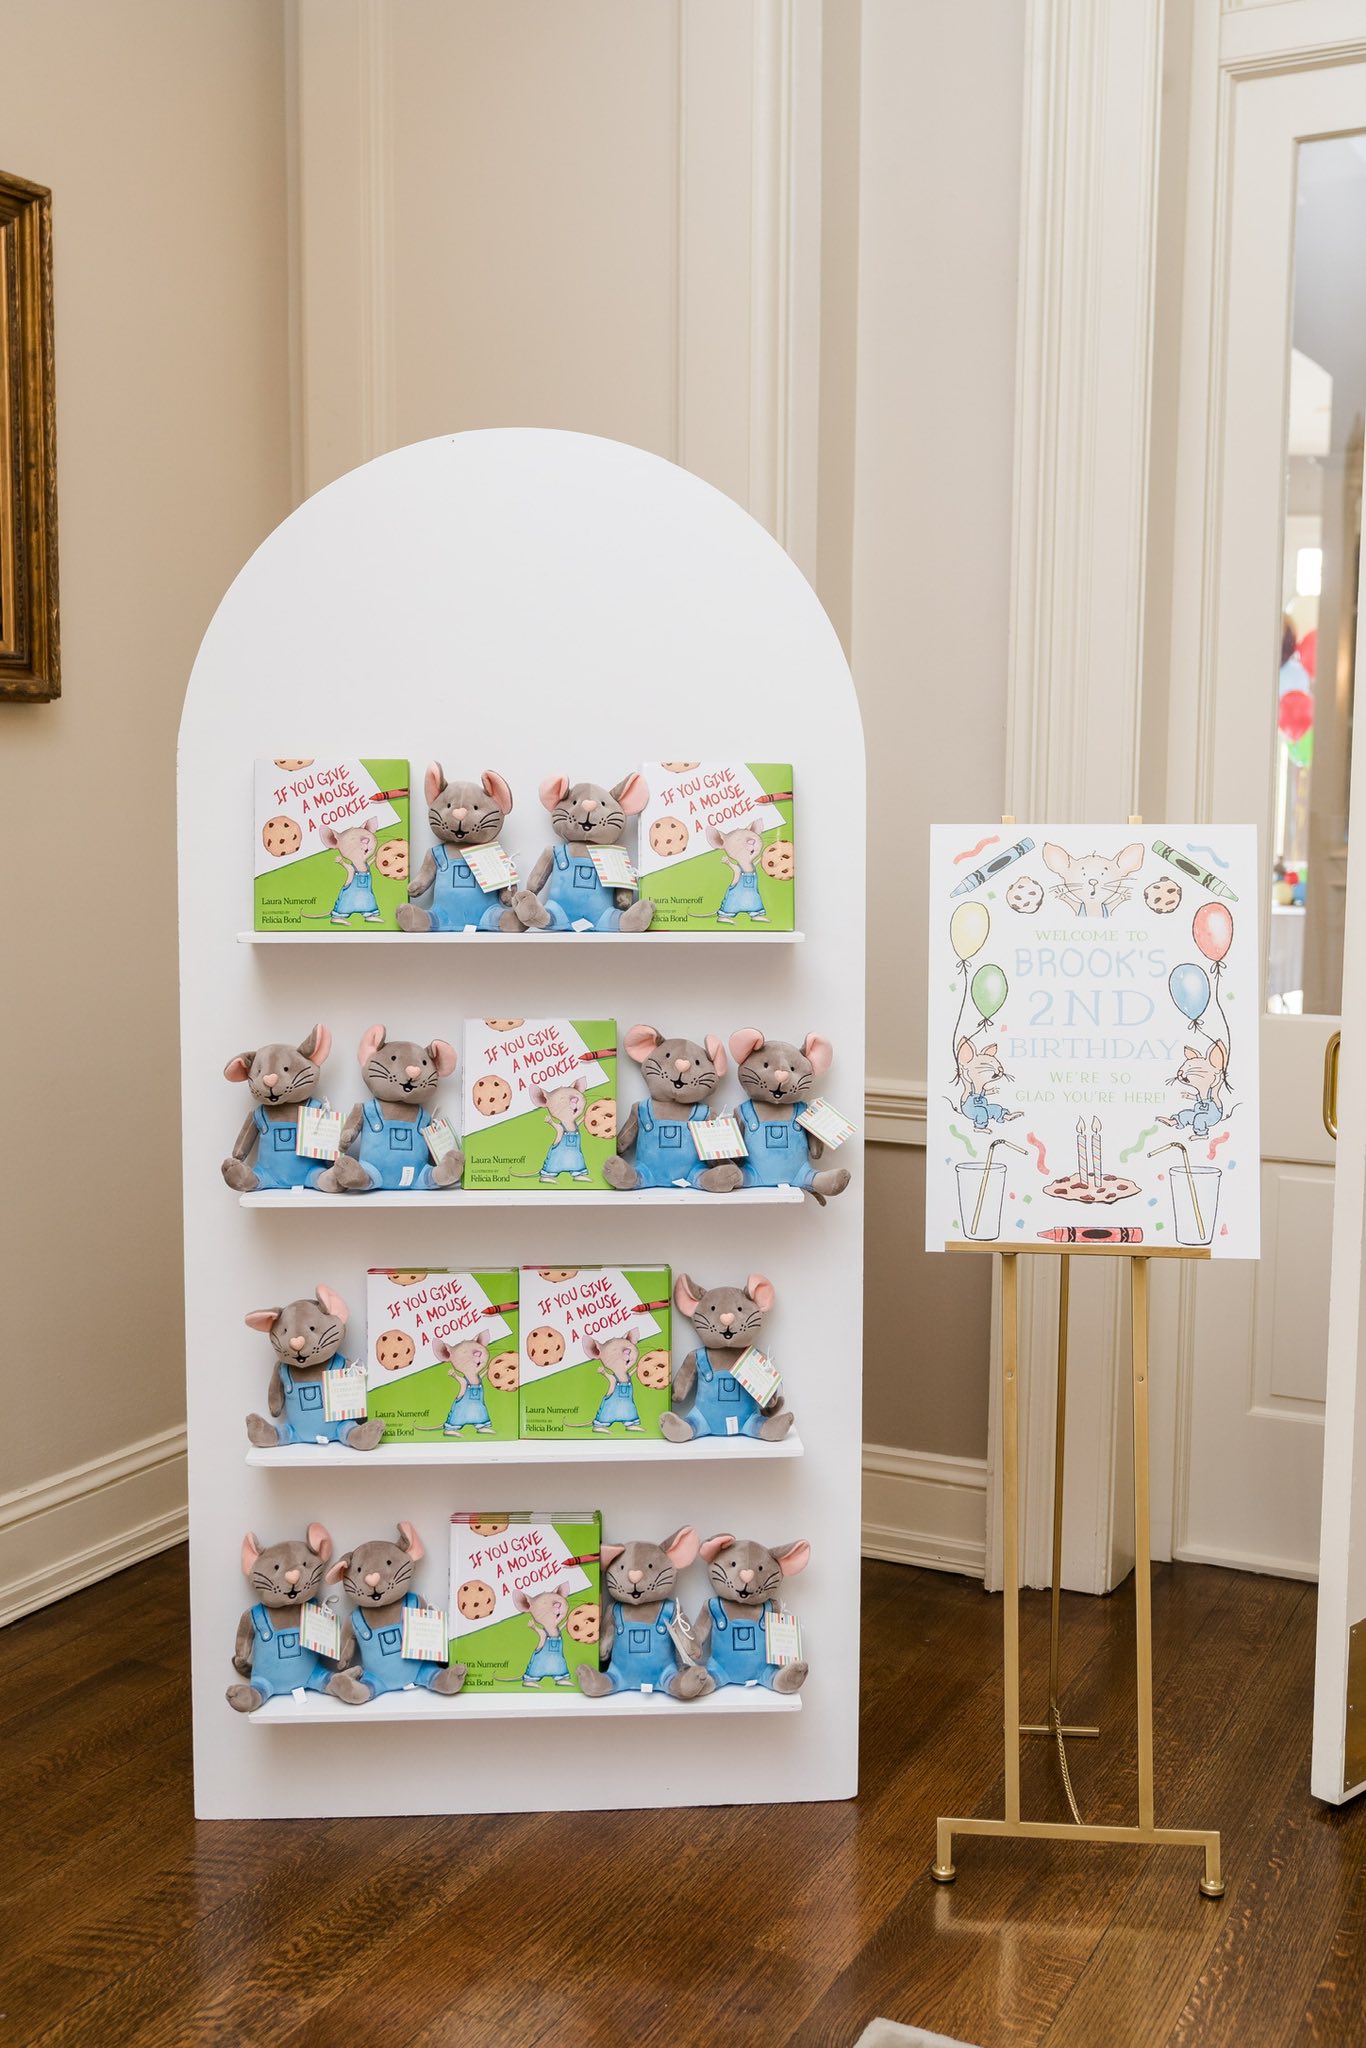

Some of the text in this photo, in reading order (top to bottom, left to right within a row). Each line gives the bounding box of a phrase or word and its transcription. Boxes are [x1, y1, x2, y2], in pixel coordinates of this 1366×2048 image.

[274, 765, 349, 805] IF YOU GIVE
[303, 781, 359, 813] A MOUSE
[660, 768, 735, 806] IF YOU GIVE
[689, 784, 745, 815] A MOUSE
[308, 795, 369, 832] A COOKIE
[695, 797, 755, 833] A COOKIE
[284, 916, 302, 924] Bond
[670, 914, 688, 922] Bond
[1035, 930, 1148, 942] WELCOME TO
[1015, 948, 1167, 978] BROOK'S
[1028, 989, 1155, 1026] 2ND
[484, 1026, 559, 1064] IF YOU GIVE
[513, 1042, 569, 1073] A MOUSE
[1008, 1037, 1180, 1060] BIRTHDAY
[518, 1055, 579, 1091] A COOKIE
[1050, 1071, 1131, 1084] WE'RE SO
[1015, 1091, 1166, 1104] GLAD YOU'RE HERE!
[492, 1174, 510, 1182] Bond
[387, 1280, 462, 1319] IF YOU GIVE
[416, 1296, 471, 1327] A MOUSE
[538, 1277, 612, 1315] IF YOU GIVE
[566, 1293, 621, 1324] A MOUSE
[421, 1309, 482, 1346] A COOKIE
[571, 1307, 631, 1343] A COOKIE
[396, 1428, 414, 1436] Bond
[546, 1424, 564, 1432] Bond
[469, 1531, 543, 1569] IF YOU GIVE
[497, 1547, 552, 1578] A MOUSE
[502, 1560, 562, 1596] A COOKIE
